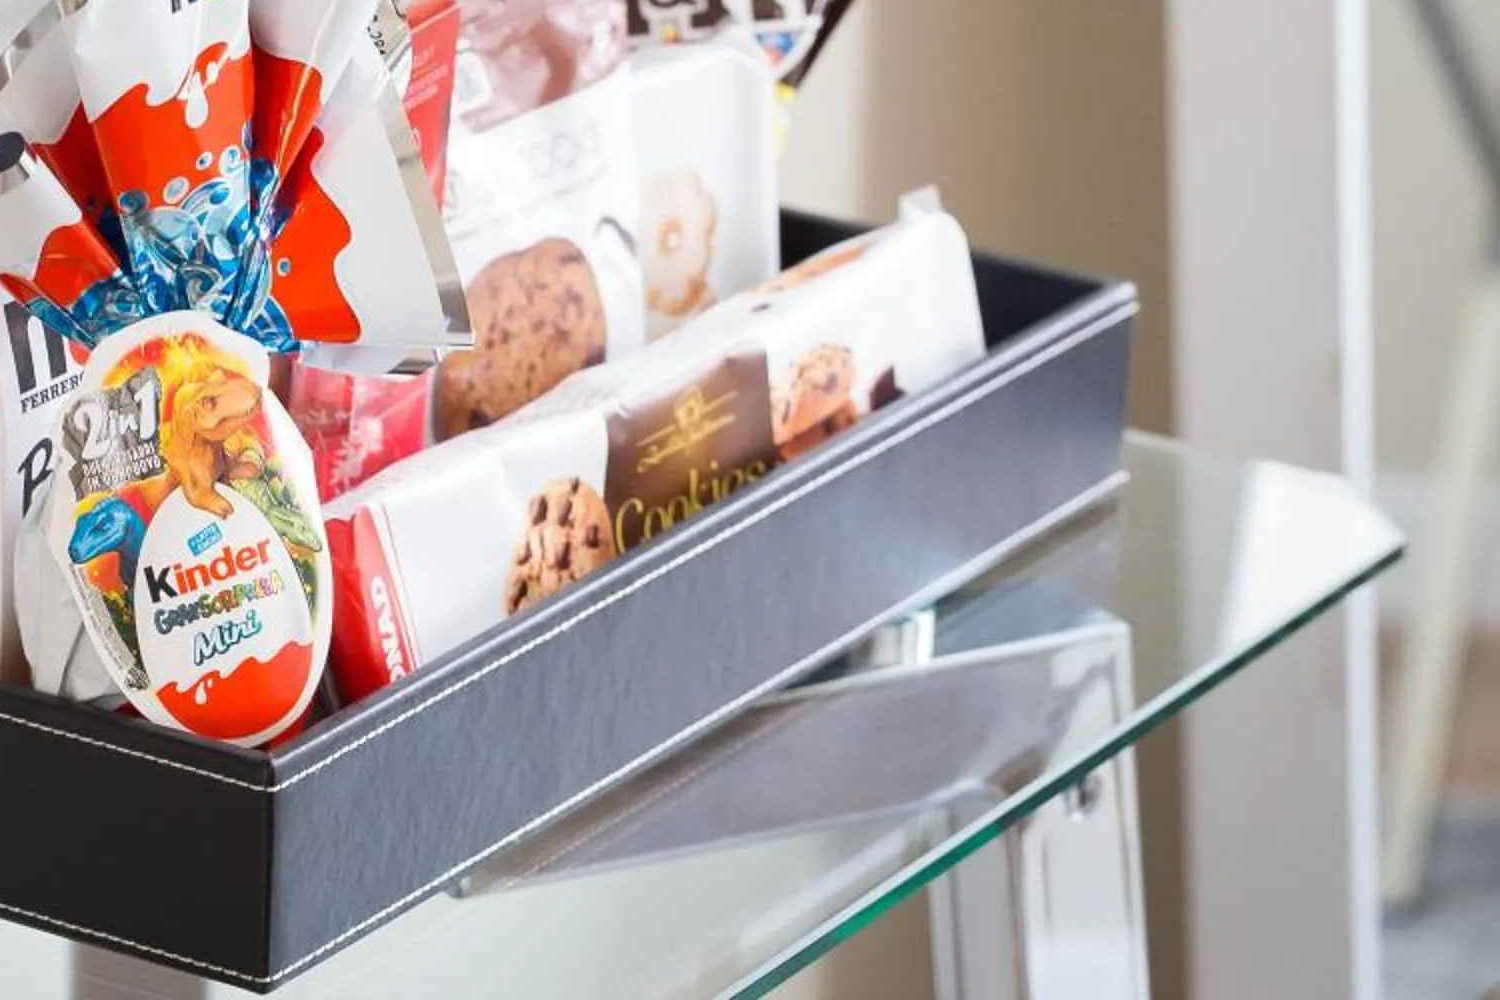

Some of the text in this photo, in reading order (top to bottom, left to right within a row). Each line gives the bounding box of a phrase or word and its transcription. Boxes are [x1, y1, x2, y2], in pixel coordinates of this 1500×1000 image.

[19, 371, 84, 414] FERRER
[143, 538, 271, 603] Kinder
[193, 608, 263, 667] Mini
